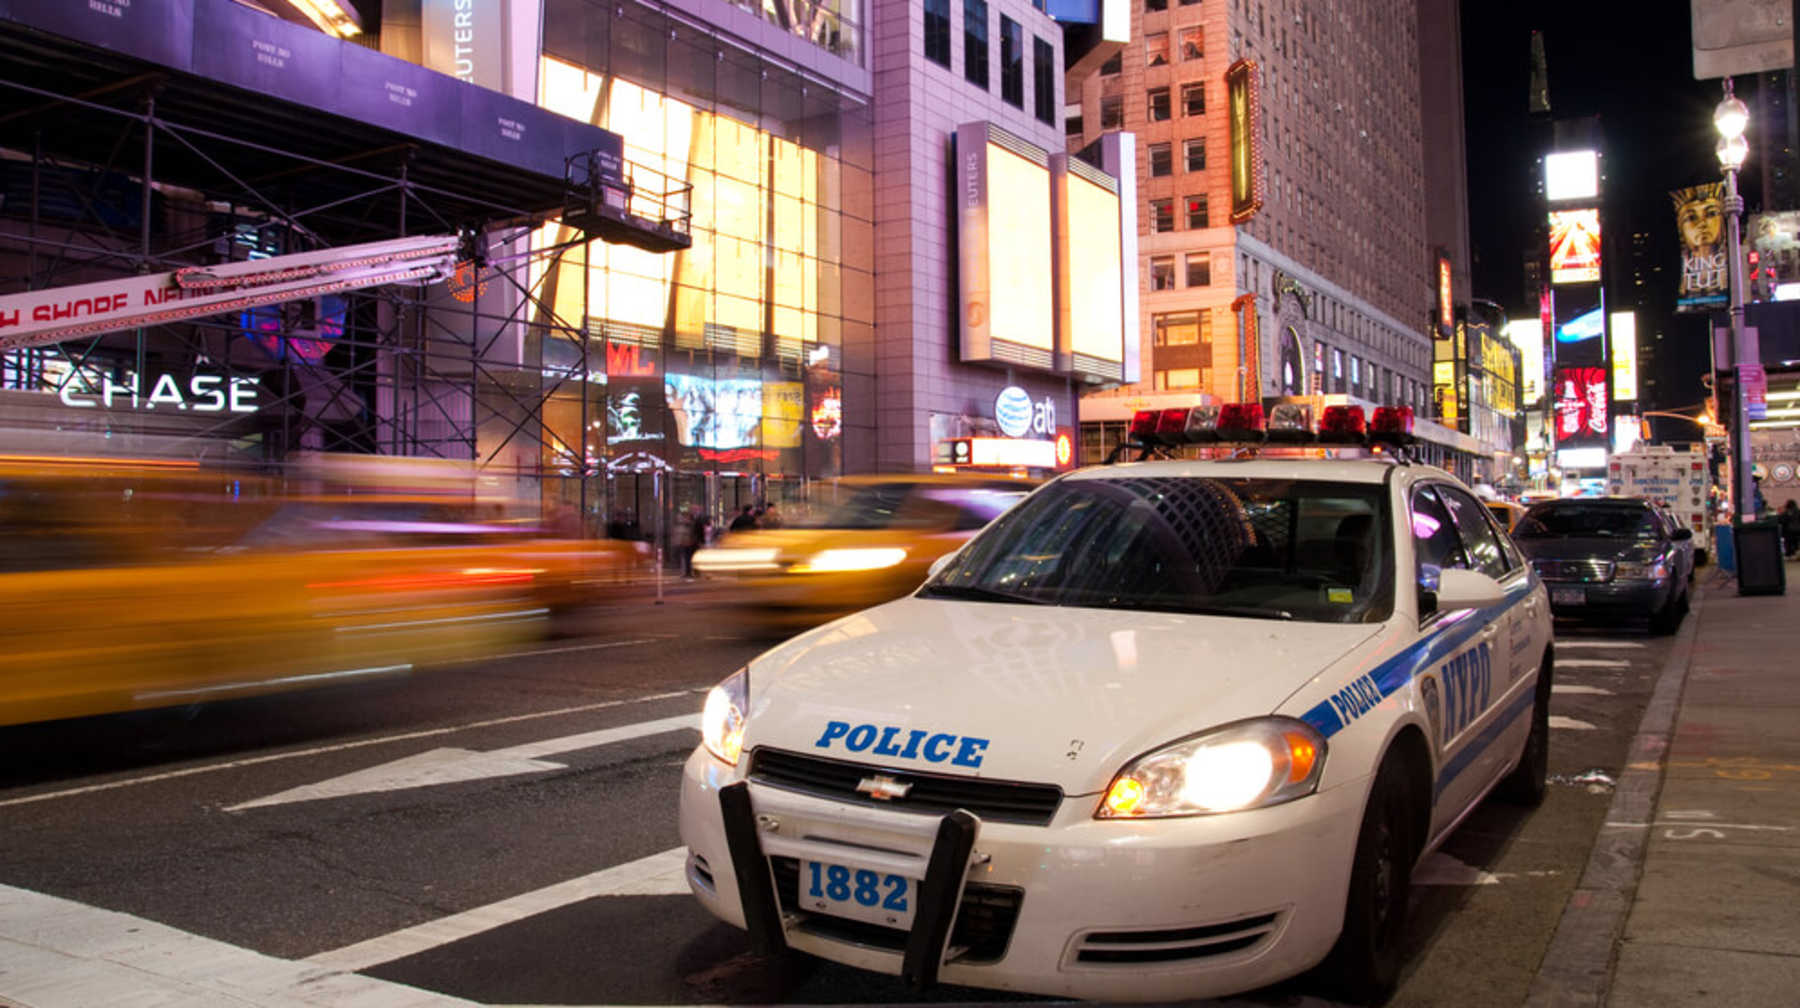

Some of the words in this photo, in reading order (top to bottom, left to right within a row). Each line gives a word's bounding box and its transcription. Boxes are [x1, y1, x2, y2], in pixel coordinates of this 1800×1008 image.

[455, 0, 473, 84] UTERS
[1683, 253, 1725, 273] KING
[1684, 268, 1726, 291] TUT
[59, 369, 260, 412] CHASE
[1330, 674, 1383, 726] POLICE
[1440, 641, 1491, 743] NYPD
[815, 721, 990, 768] POLICE
[809, 862, 908, 912] 1882
